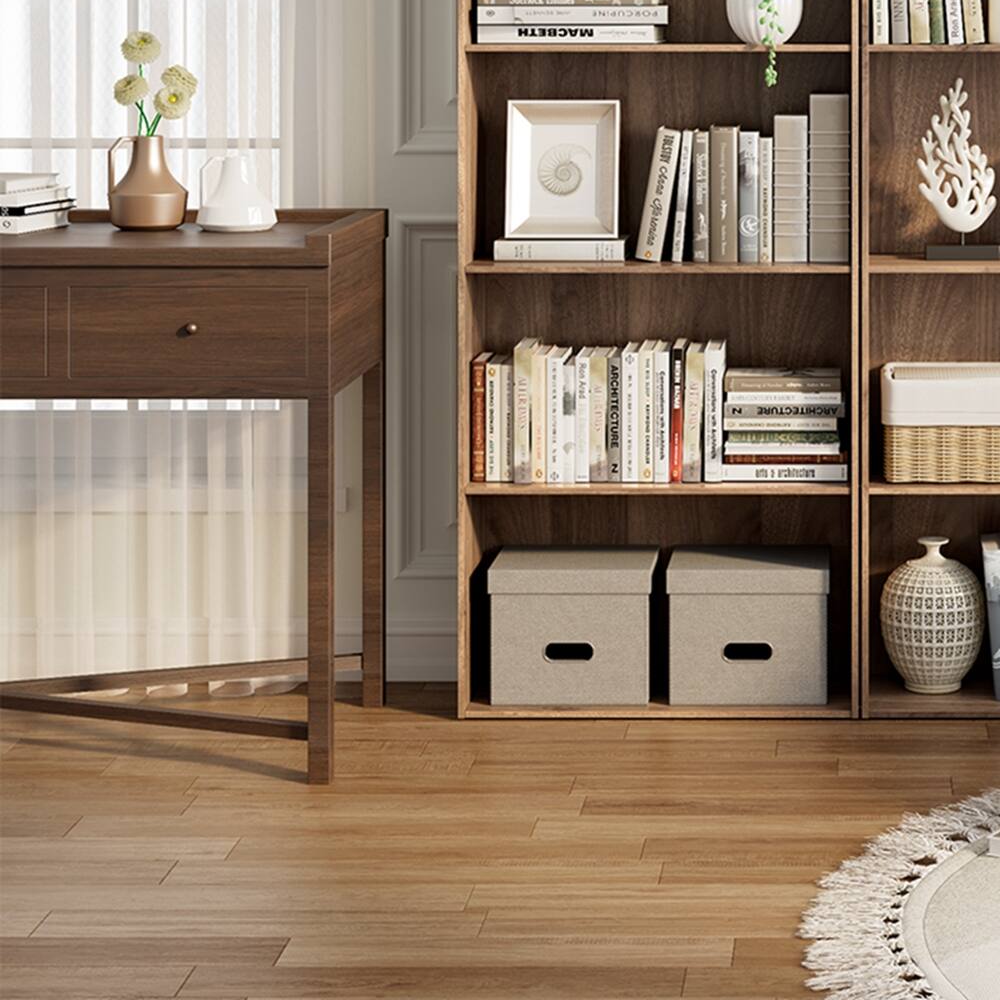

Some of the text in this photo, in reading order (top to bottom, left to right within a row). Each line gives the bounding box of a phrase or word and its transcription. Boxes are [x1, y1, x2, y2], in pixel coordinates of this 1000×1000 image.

[517, 28, 594, 37] MACBETH
[951, 19, 960, 37] Ron
[659, 134, 675, 164] TOLSTOY
[655, 166, 669, 197] Anna
[579, 363, 587, 379] Ron
[579, 381, 587, 400] Arad
[610, 365, 619, 448] ARCHITECTURE
[757, 407, 838, 415] ARCHITECTURE
